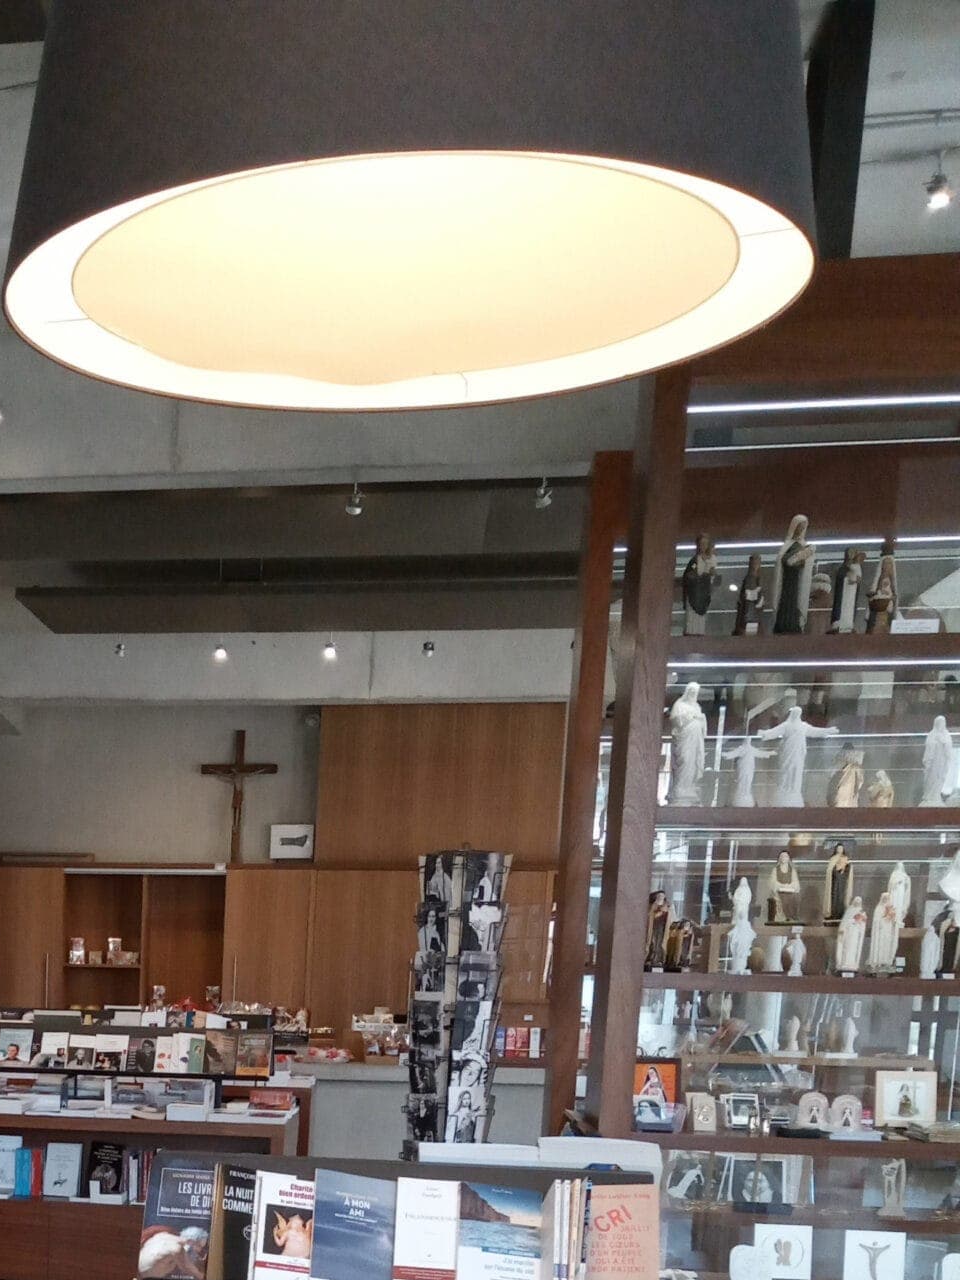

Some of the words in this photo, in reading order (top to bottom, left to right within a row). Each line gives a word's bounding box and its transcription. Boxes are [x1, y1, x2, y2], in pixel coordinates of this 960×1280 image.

[178, 1182, 191, 1194] LES
[194, 1183, 214, 1195] LIVR
[225, 1185, 234, 1197] LA
[235, 1187, 254, 1200] NUIT
[191, 1195, 200, 1207] DE
[202, 1197, 213, 1208] DI
[222, 1199, 254, 1214] COMME
[349, 1207, 365, 1218] AMI
[593, 1204, 633, 1232] CRI
